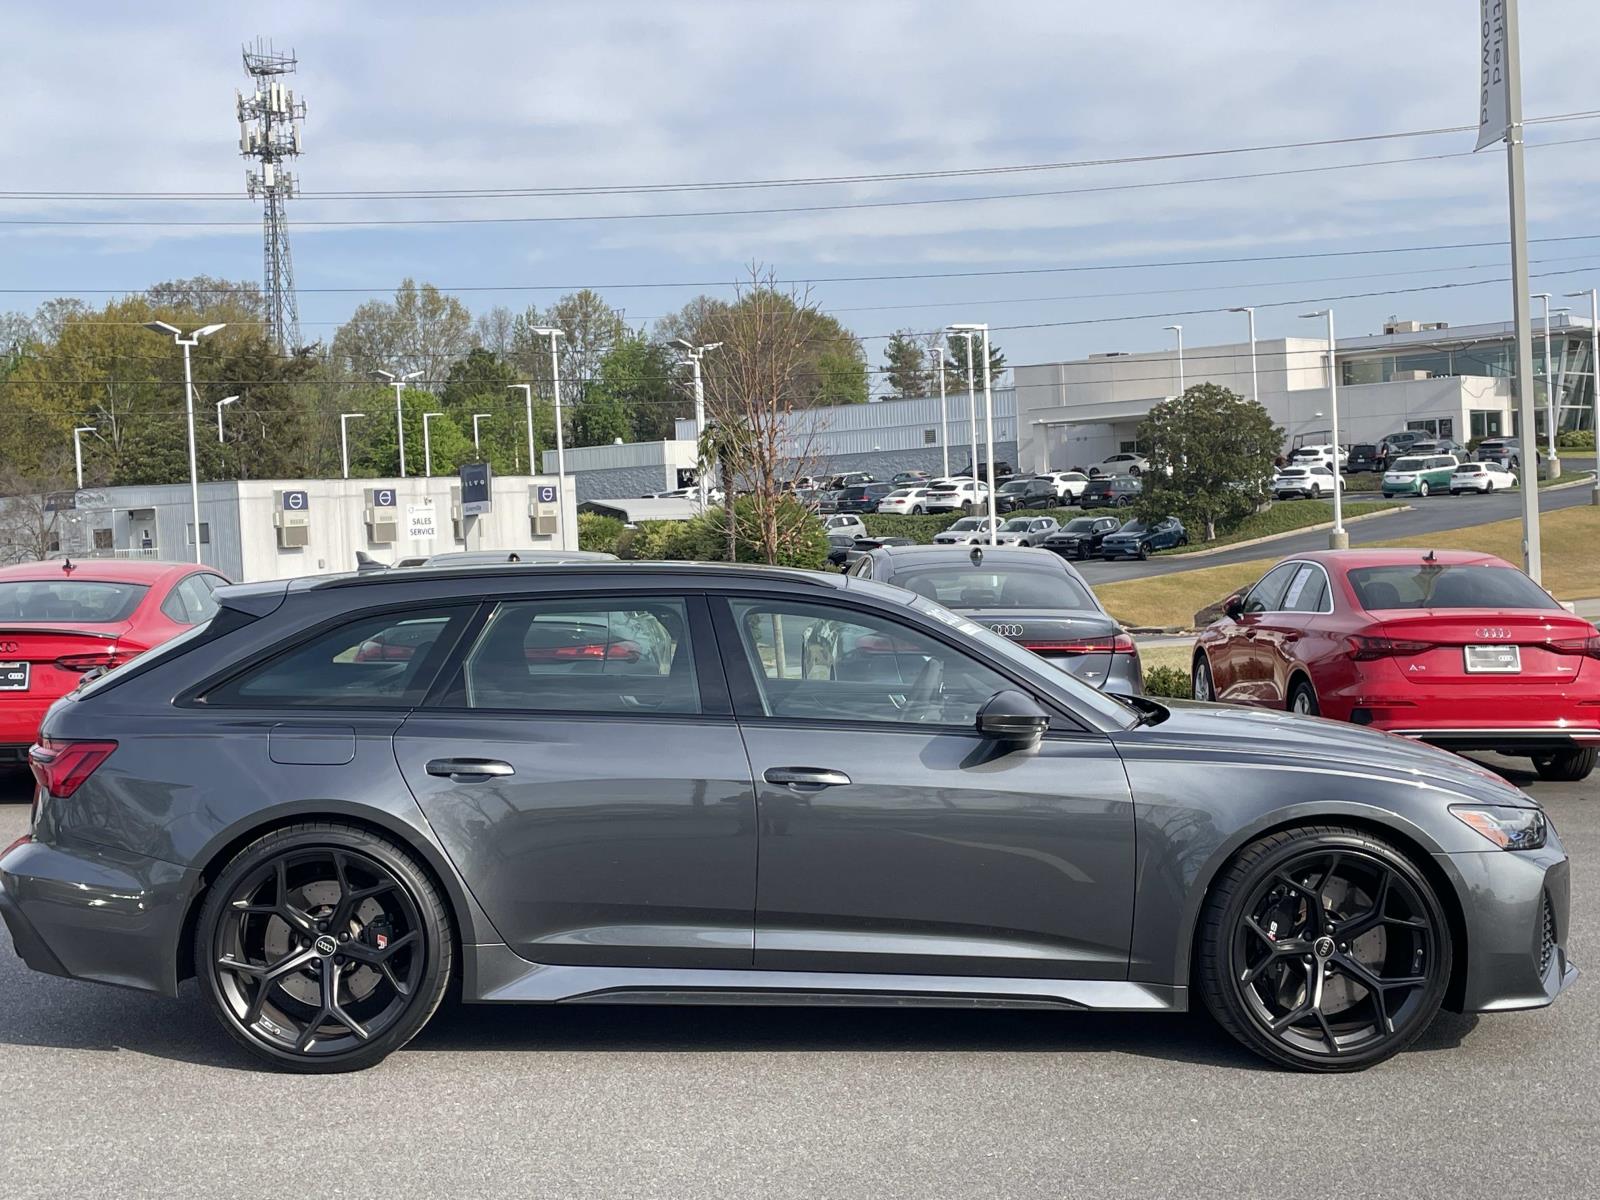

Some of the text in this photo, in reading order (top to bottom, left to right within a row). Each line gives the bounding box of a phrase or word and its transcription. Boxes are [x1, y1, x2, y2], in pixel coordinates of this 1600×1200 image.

[461, 479, 485, 488] LVO
[412, 517, 432, 526] SALES
[409, 527, 435, 536] SERVICE
